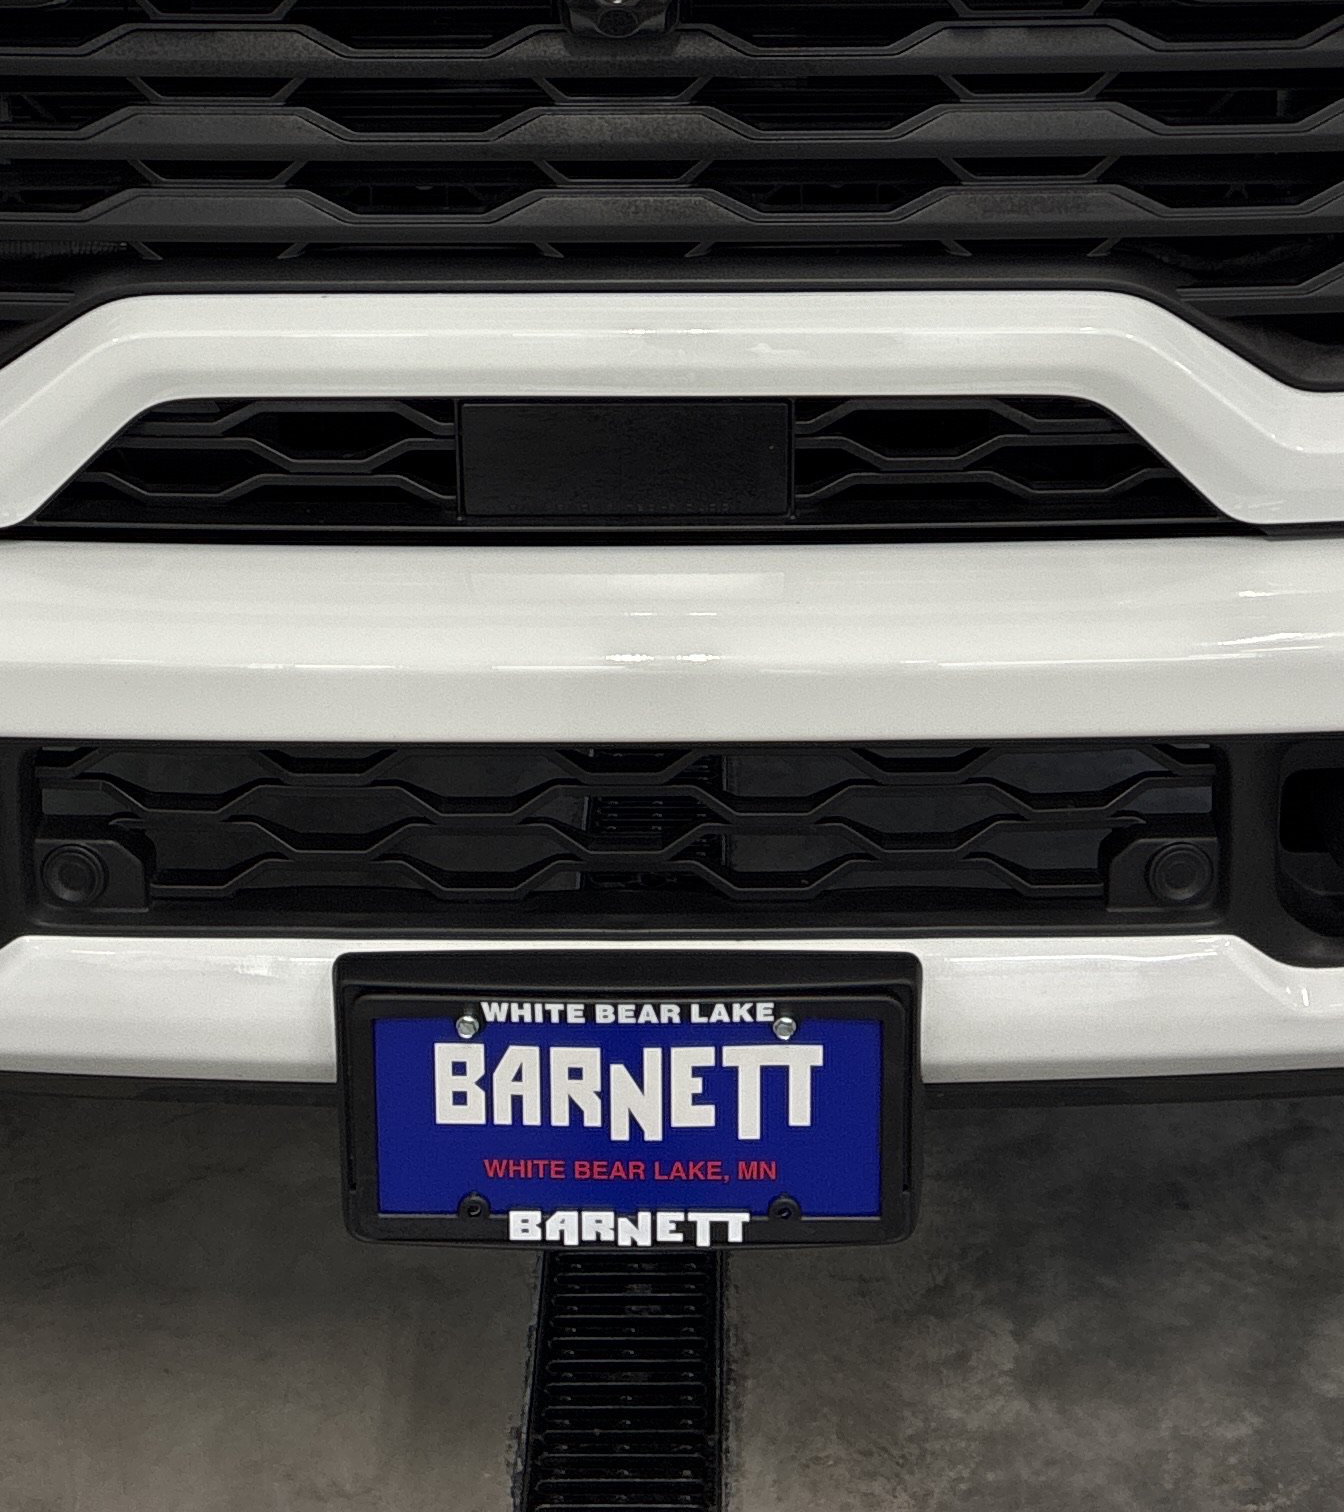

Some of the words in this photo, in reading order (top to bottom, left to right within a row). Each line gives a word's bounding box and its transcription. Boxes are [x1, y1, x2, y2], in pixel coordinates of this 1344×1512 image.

[480, 1001, 585, 1024] WHITE
[595, 1002, 680, 1024] BEAR
[690, 1001, 775, 1023] LAKE
[433, 1042, 824, 1141] BARNETT
[484, 1159, 563, 1180] WHITE
[574, 1160, 645, 1181] BEAR
[654, 1160, 730, 1183] LAKE,
[738, 1161, 777, 1181] MN
[508, 1210, 750, 1247] BARNETT
